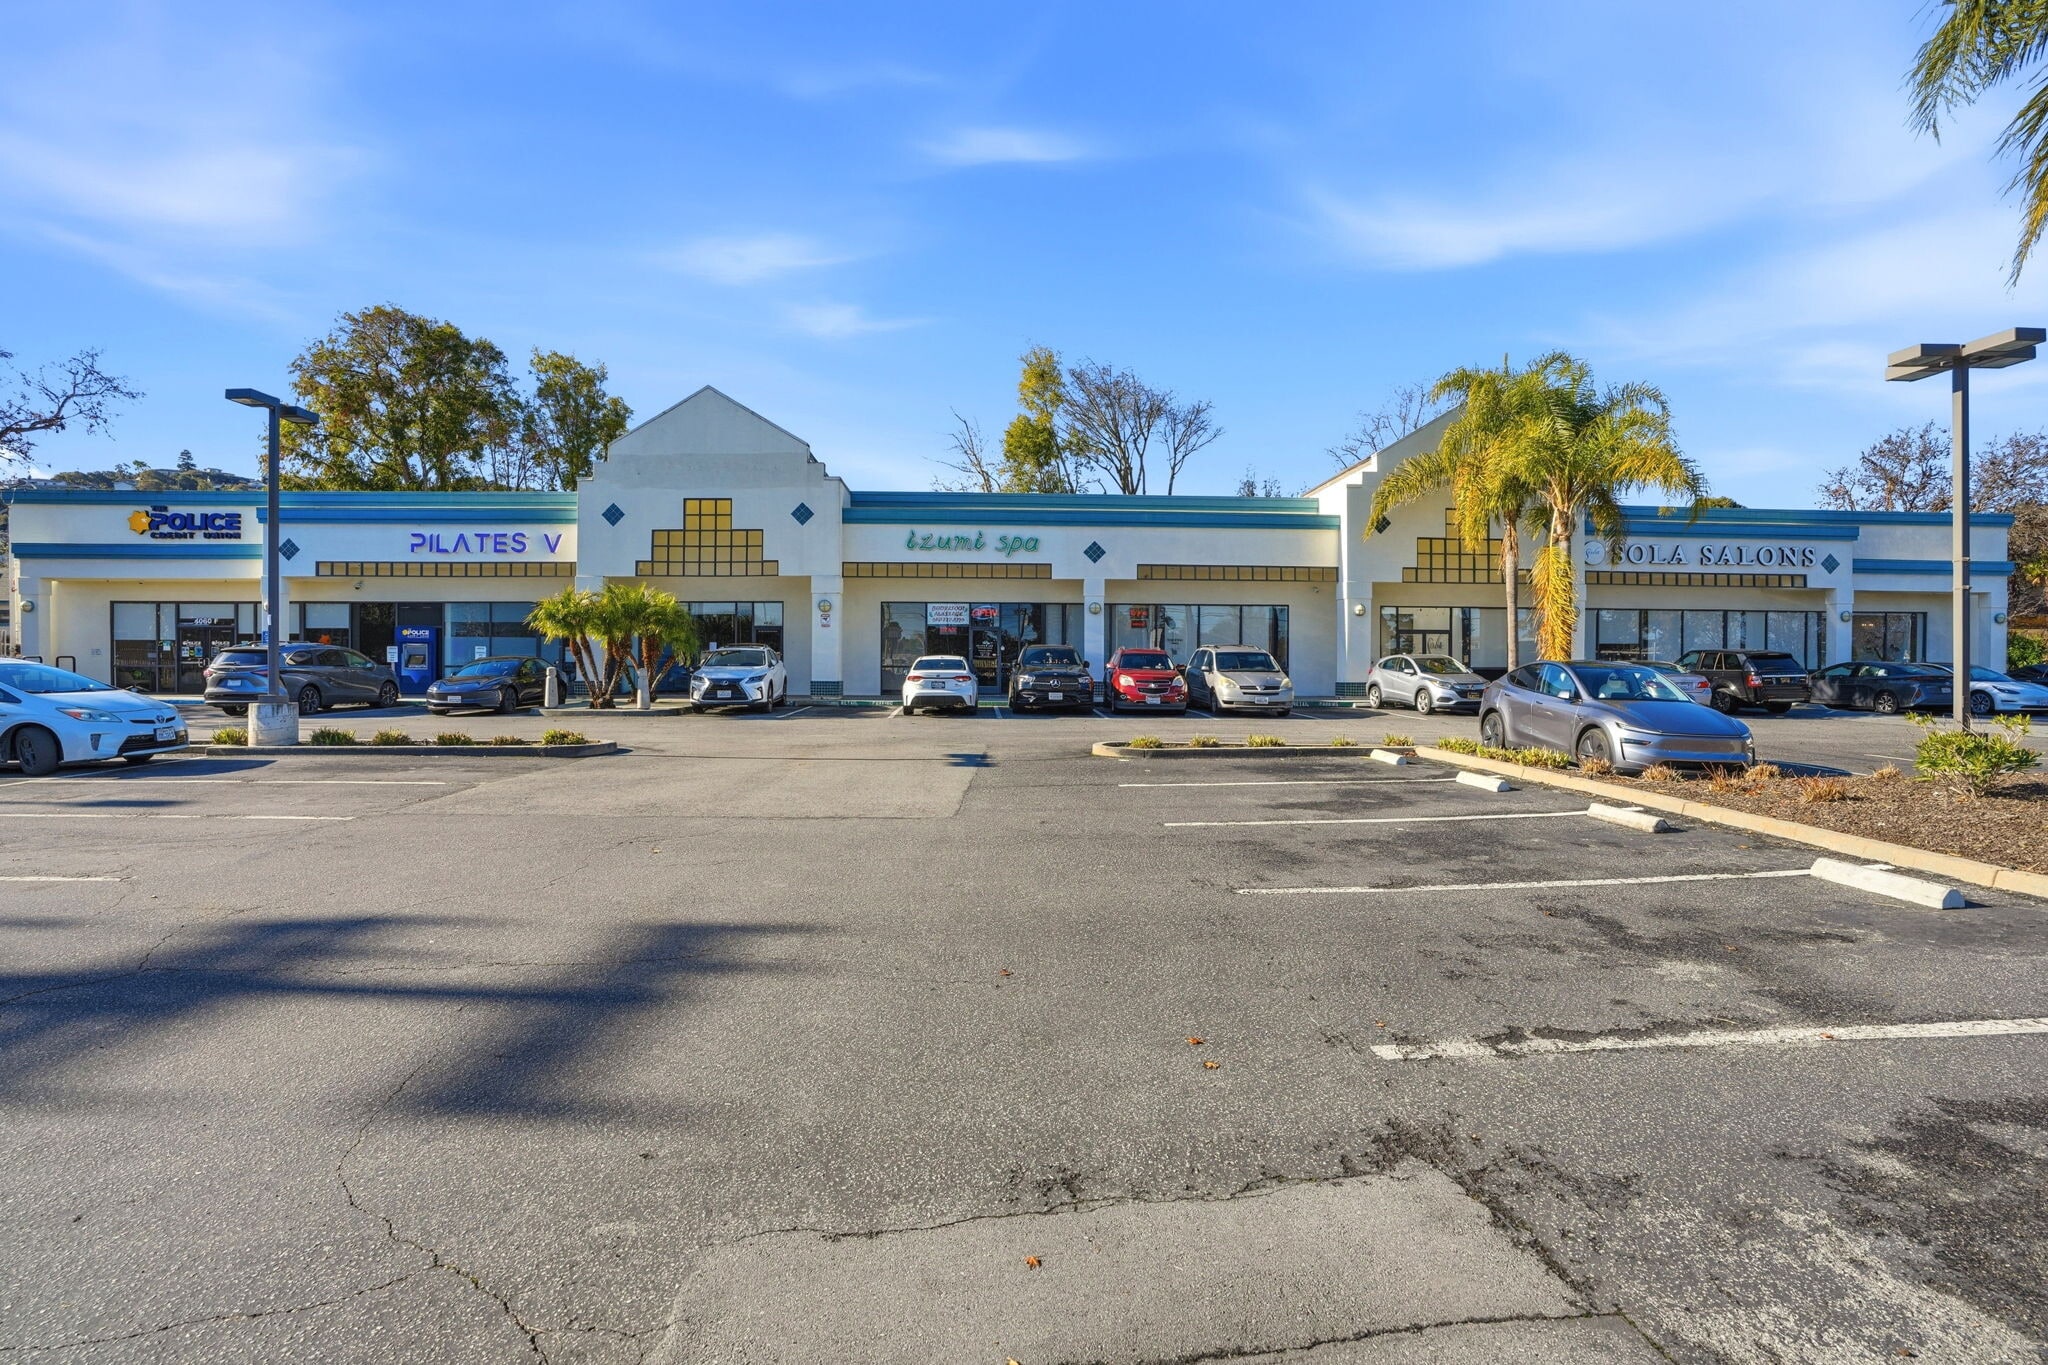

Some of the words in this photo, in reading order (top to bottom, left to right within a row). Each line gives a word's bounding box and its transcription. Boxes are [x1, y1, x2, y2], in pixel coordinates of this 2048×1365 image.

[150, 512, 242, 531] POLICE
[150, 532, 196, 540] CREDIT
[203, 532, 242, 540] UNION
[410, 532, 528, 553] PILATES
[544, 533, 562, 553] V
[905, 530, 986, 552] izumi
[994, 535, 1040, 557] spa
[1700, 545, 1817, 567] SALONS
[971, 608, 999, 618] OPEN
